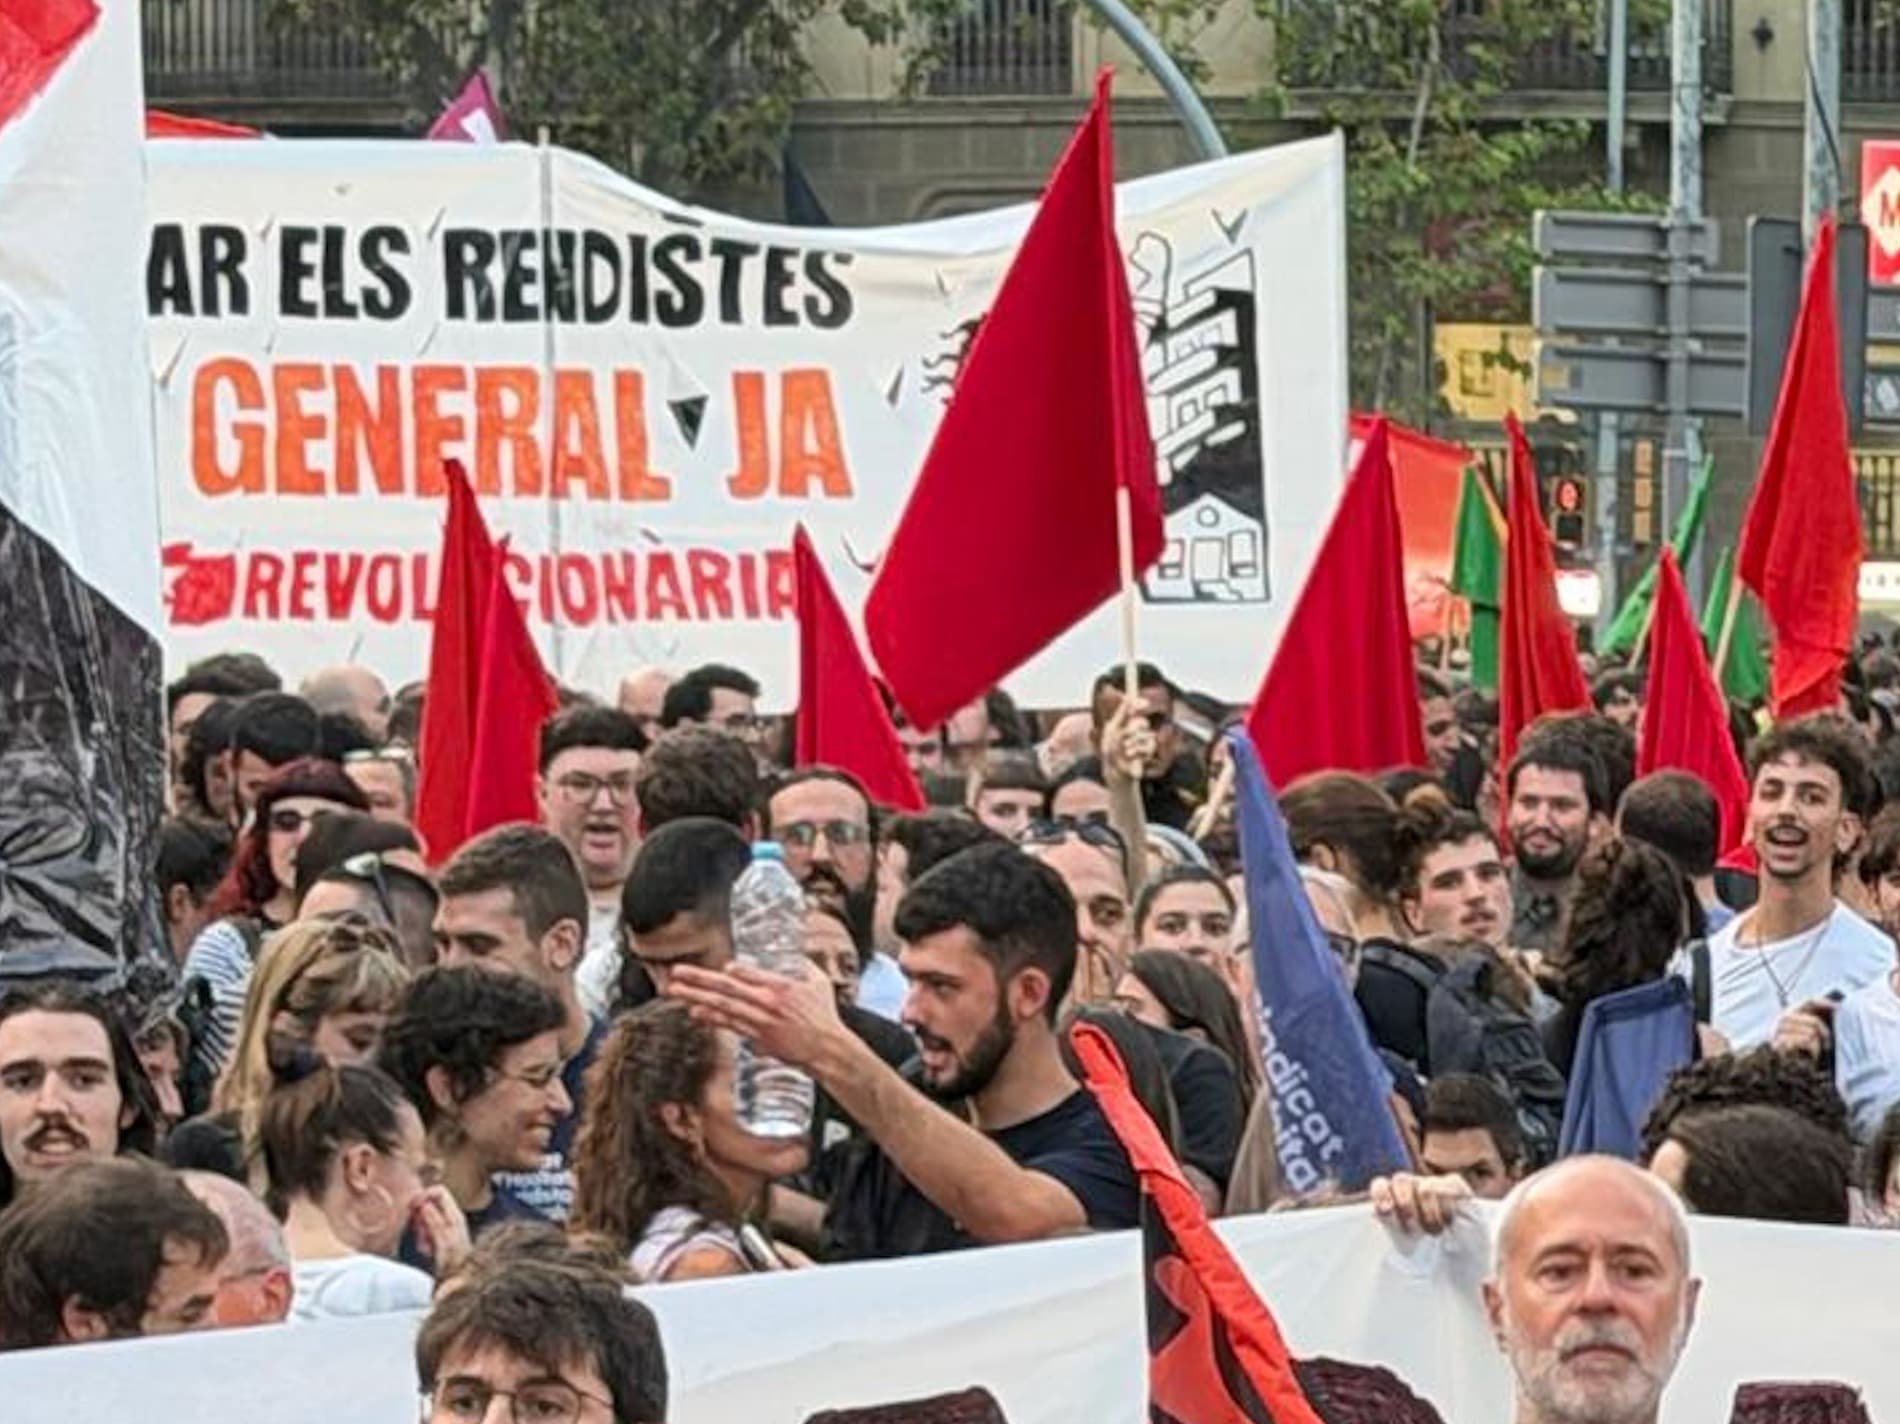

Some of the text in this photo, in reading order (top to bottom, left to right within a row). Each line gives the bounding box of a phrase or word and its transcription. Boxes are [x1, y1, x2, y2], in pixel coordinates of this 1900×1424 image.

[147, 224, 855, 329] AR ELS RENDISTES
[190, 356, 854, 502] GENERAL JA
[242, 550, 798, 626] REVOLCIONARIA
